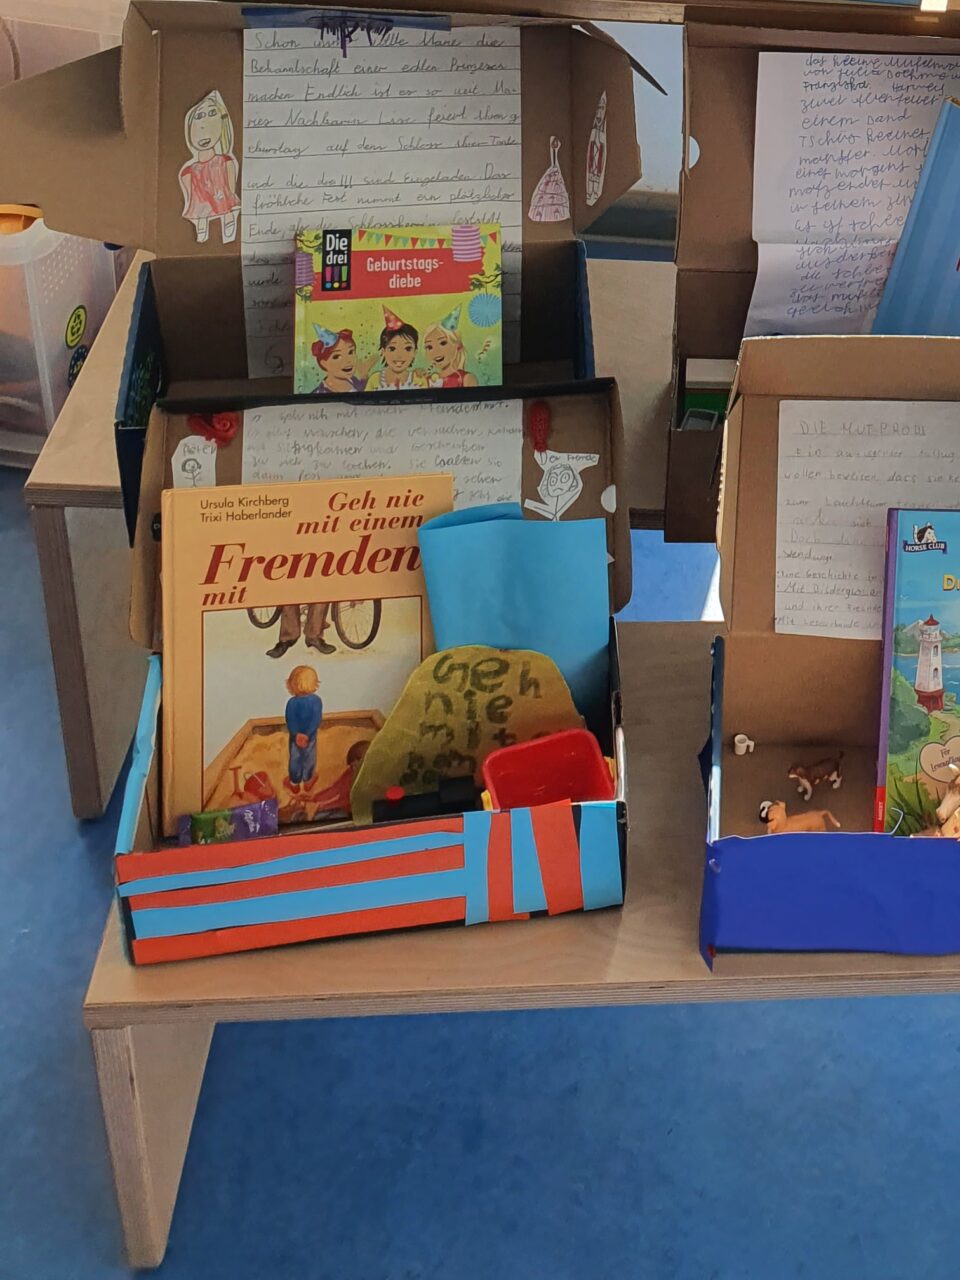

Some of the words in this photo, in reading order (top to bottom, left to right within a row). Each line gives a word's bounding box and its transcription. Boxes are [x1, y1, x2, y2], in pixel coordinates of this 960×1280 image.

[325, 233, 348, 251] Die
[326, 251, 348, 265] drei
[366, 256, 444, 273] Geburtstags-
[389, 274, 421, 289] diebe
[200, 498, 234, 510] Ursula
[238, 496, 289, 511] Kirchberg
[328, 490, 376, 512] Geh
[386, 489, 424, 508] nie
[200, 513, 222, 523] Trixi
[226, 508, 293, 521] Haberlander
[296, 515, 340, 535] mit
[349, 512, 424, 532] einem
[905, 543, 927, 551] HORSE
[928, 542, 945, 550] CLUB
[198, 533, 421, 586] Fremden
[202, 584, 247, 606] mit
[432, 653, 542, 699] Geh
[423, 688, 513, 724] nie
